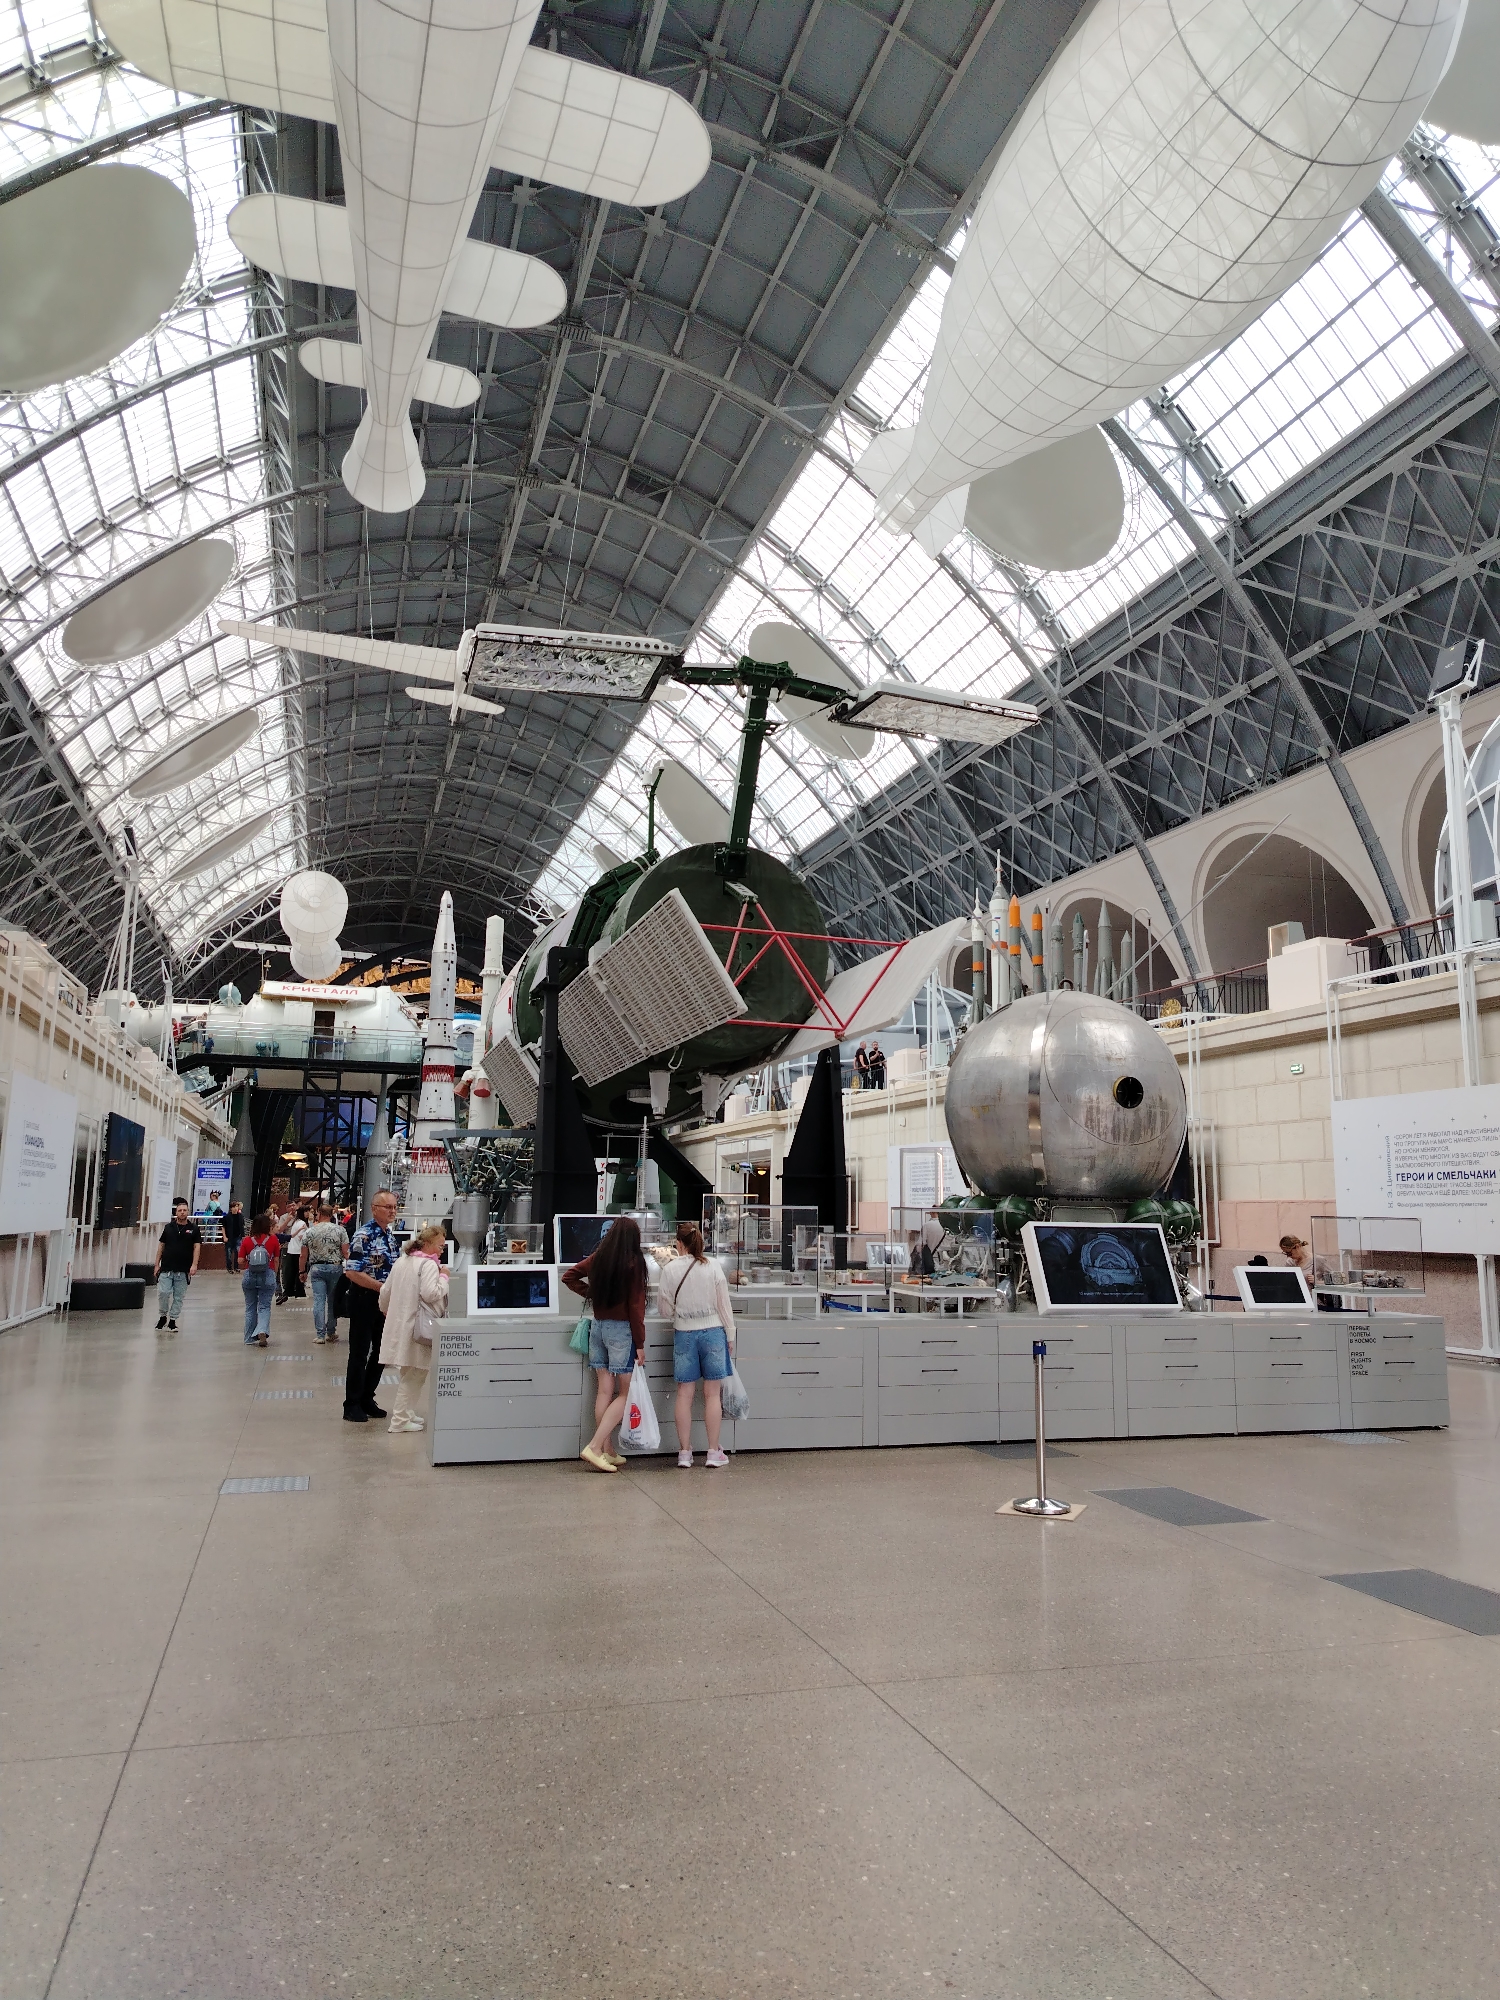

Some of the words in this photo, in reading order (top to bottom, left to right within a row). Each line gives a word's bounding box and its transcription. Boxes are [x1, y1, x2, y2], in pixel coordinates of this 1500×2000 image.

[282, 985, 358, 995] КРИСТАЛЛ
[1428, 1130, 1451, 1138] РАБОТАЛ
[1396, 1172, 1424, 1181] ГЕРОИ
[1428, 1172, 1434, 1180] И
[1436, 1170, 1496, 1180] СМЕЛЬЧАКИ
